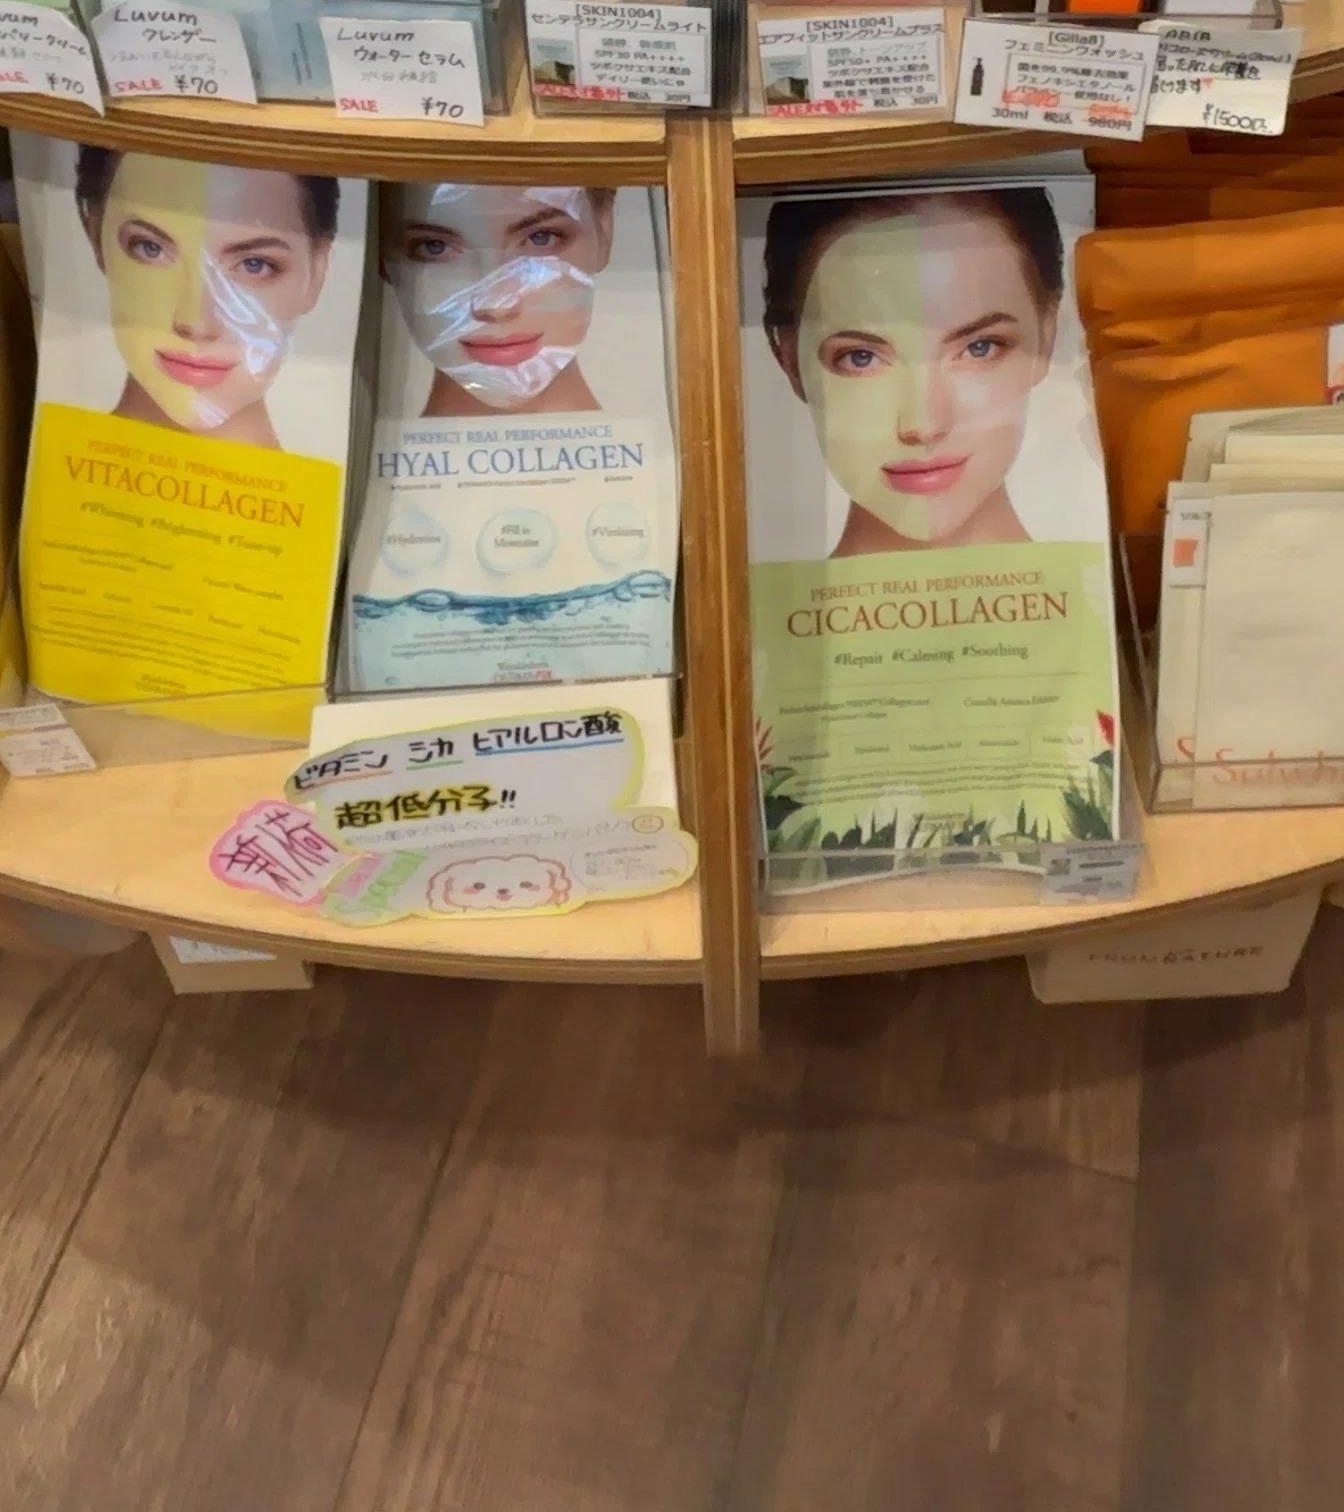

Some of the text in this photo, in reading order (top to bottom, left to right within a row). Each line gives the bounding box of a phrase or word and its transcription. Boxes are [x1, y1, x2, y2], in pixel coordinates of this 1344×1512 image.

[113, 6, 199, 27] Luvum
[575, 4, 662, 21] [SKIN1004]
[806, 15, 895, 33] [SKIN1004]
[336, 26, 415, 44] Luvum
[174, 76, 219, 96] ¥70
[338, 97, 466, 120] SALE ¥70
[401, 429, 464, 446] PERFECT
[504, 424, 614, 443] PERFORMANCE
[376, 442, 645, 479] HYAL COLLAGEN
[182, 461, 288, 493] PERFORMANCE
[64, 454, 306, 528] VITACOLLAGEN
[809, 570, 1046, 603] PERFECT REAL PERFORMANCE
[785, 591, 1070, 639] CICACOLLAGEN
[833, 641, 1030, 670] #Repair #Calming #Soothing
[292, 709, 625, 790] ビタミン シカ ヒアルロン酸
